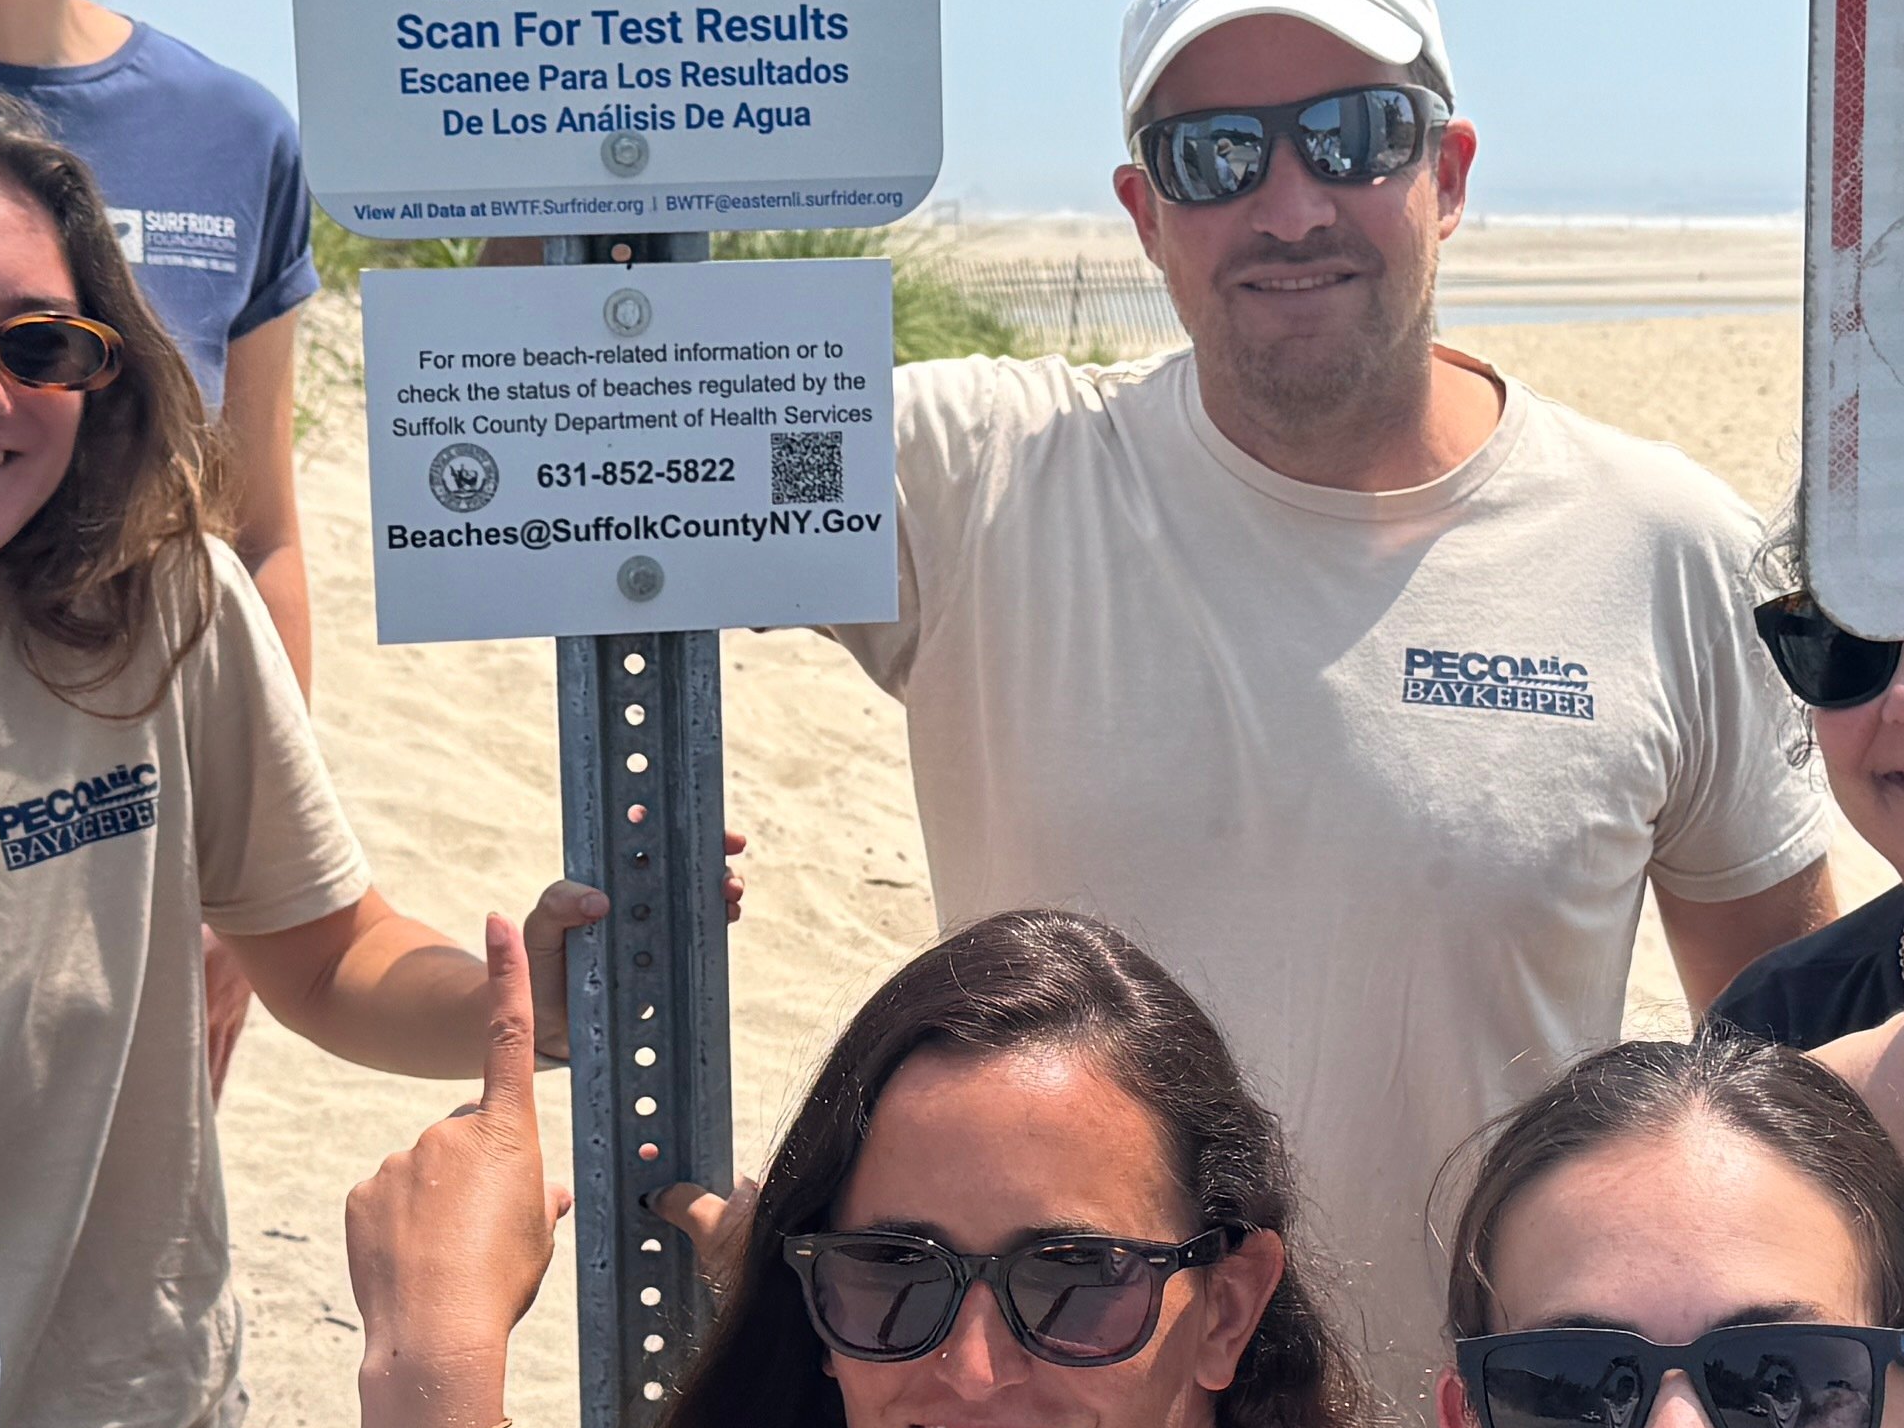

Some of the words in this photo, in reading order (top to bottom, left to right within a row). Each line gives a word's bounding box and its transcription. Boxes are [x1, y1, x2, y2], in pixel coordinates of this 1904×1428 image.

[398, 14, 499, 49] Scan
[515, 12, 580, 47] For
[591, 10, 683, 45] Test
[697, 4, 848, 43] Results
[401, 68, 529, 94] Escanee
[540, 65, 607, 91] Para
[618, 63, 671, 88] Los
[681, 57, 848, 87] Resultados
[443, 110, 483, 135] De
[493, 108, 546, 134] Los
[556, 103, 675, 133] Análisis
[686, 104, 724, 129] De
[733, 102, 810, 134] Agua
[146, 210, 236, 238] SURFRIDER
[354, 205, 395, 220] View
[401, 203, 422, 219] All
[427, 204, 465, 218] Data
[471, 203, 486, 216] at
[491, 198, 643, 216] BWTF.Surfrider.org
[420, 351, 454, 369] For
[462, 353, 516, 368] more
[523, 344, 667, 366] beach-related
[675, 342, 789, 361] information
[797, 345, 818, 358] or
[824, 341, 843, 358] to
[398, 383, 460, 403] check
[468, 383, 499, 401] the
[507, 382, 570, 400] status
[577, 379, 596, 397] of
[604, 377, 692, 397] beaches
[699, 374, 795, 398] regulated
[803, 373, 827, 395] by
[834, 372, 865, 390] the
[393, 417, 465, 436] Suffolk
[473, 415, 547, 437] County
[555, 410, 677, 435] Department
[684, 408, 704, 427] of
[711, 407, 776, 426] Health
[785, 405, 872, 424] Services
[538, 458, 735, 488] 631-852-5822
[388, 509, 881, 550] Beaches@SuffolkCountyNY.Gov
[1405, 679, 1592, 718] BAYKEEPER
